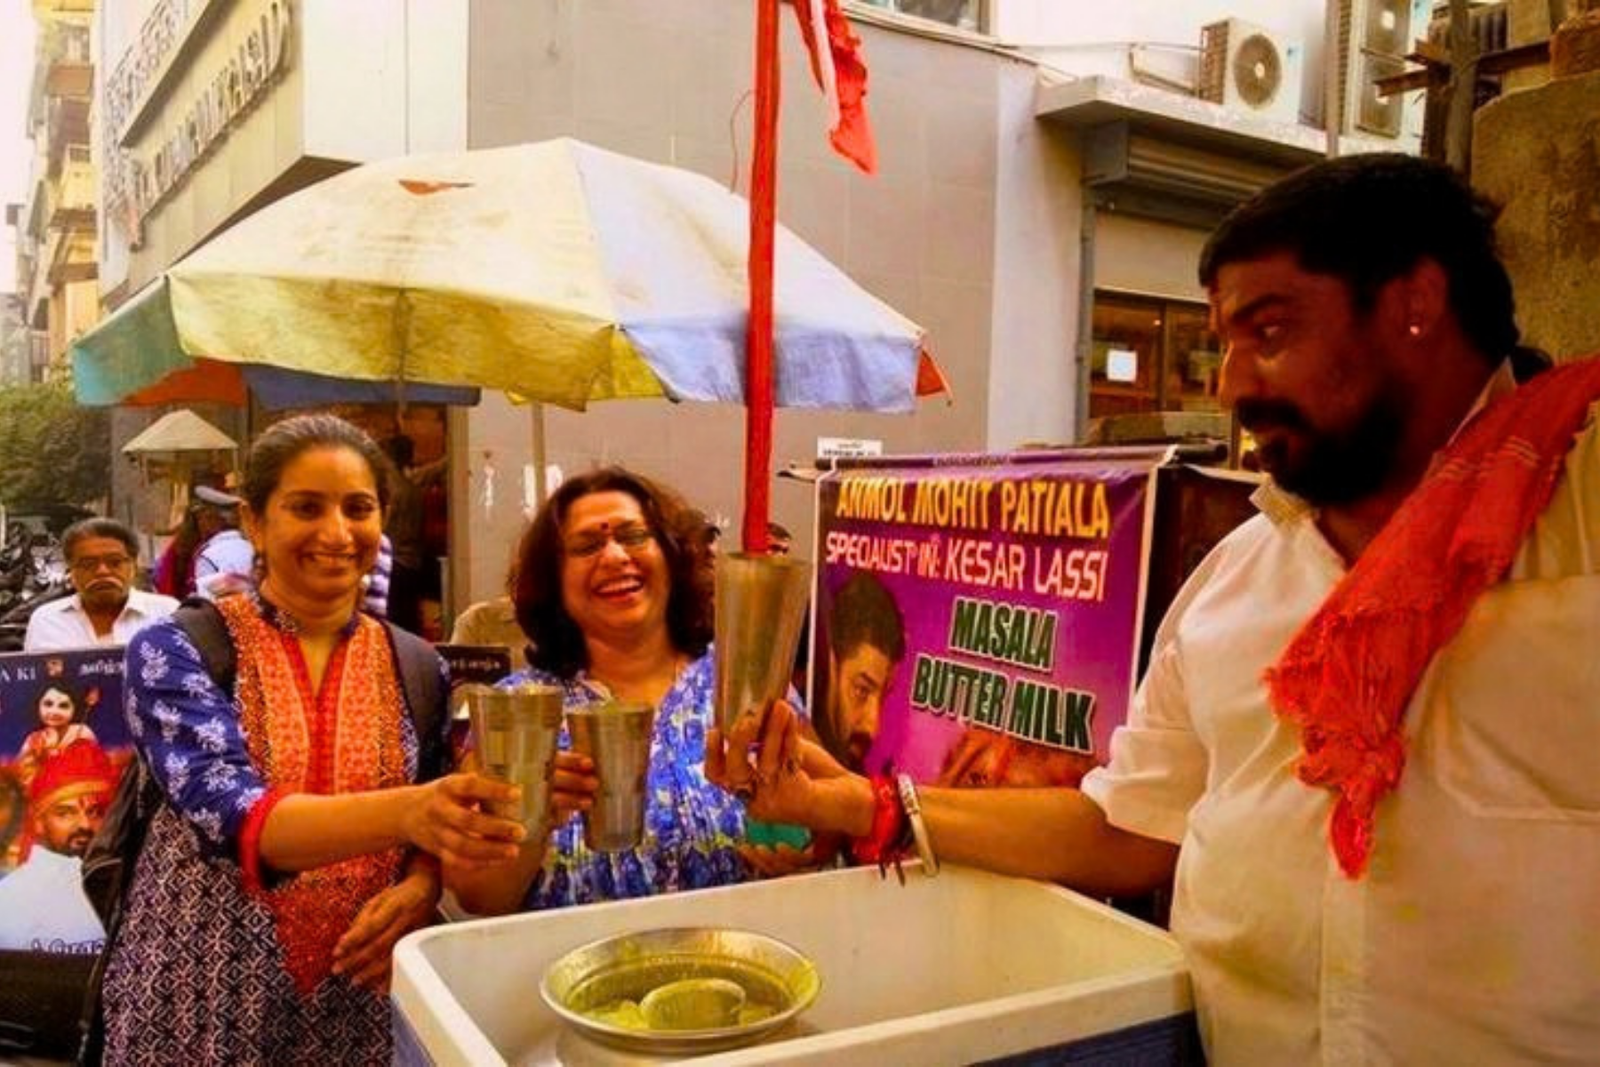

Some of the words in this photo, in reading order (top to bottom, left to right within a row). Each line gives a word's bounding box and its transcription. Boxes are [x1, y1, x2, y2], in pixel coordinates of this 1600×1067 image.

[836, 476, 908, 522] ANMOL
[911, 478, 993, 530] MOHIT
[999, 481, 1110, 539] PATIALA
[945, 537, 1025, 591] KESAR
[1033, 549, 1109, 601] LASSI
[949, 597, 1059, 673] MASALA
[911, 655, 1008, 730] BUTTER
[1009, 681, 1096, 754] MILK
